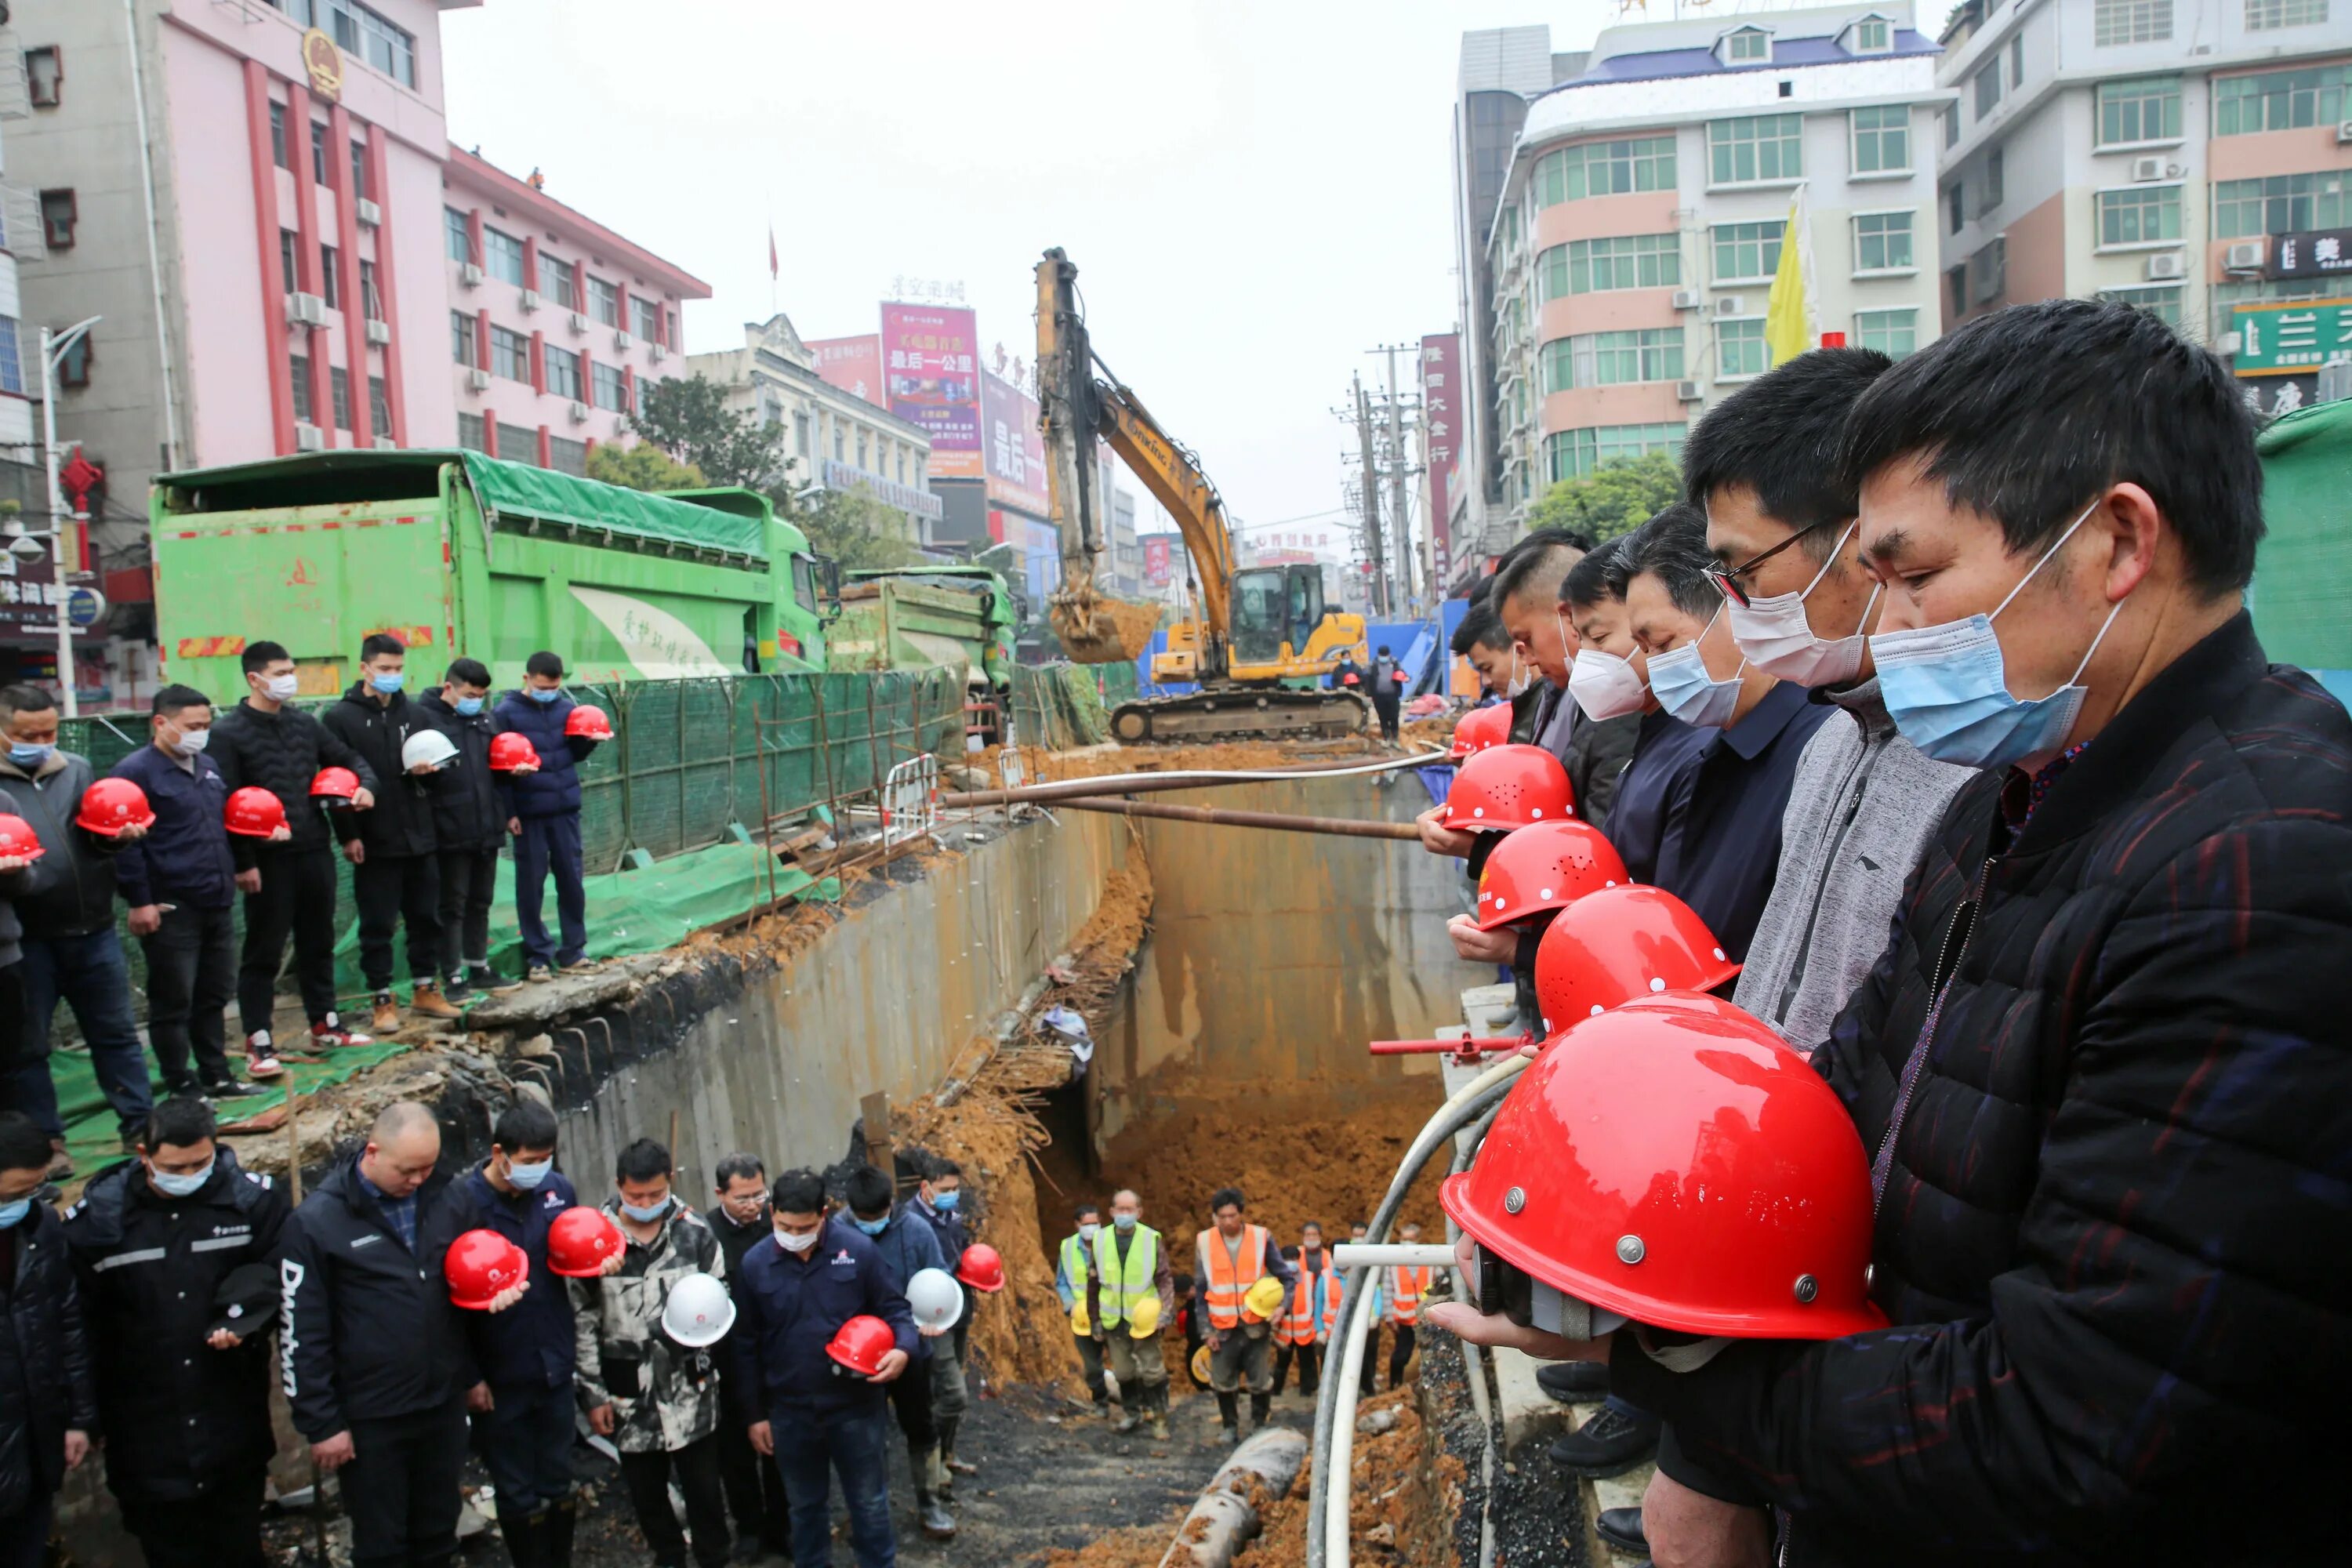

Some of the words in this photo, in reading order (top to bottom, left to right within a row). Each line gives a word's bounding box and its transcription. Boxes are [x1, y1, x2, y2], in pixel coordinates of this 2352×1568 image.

[890, 350, 973, 372] 最后一公里
